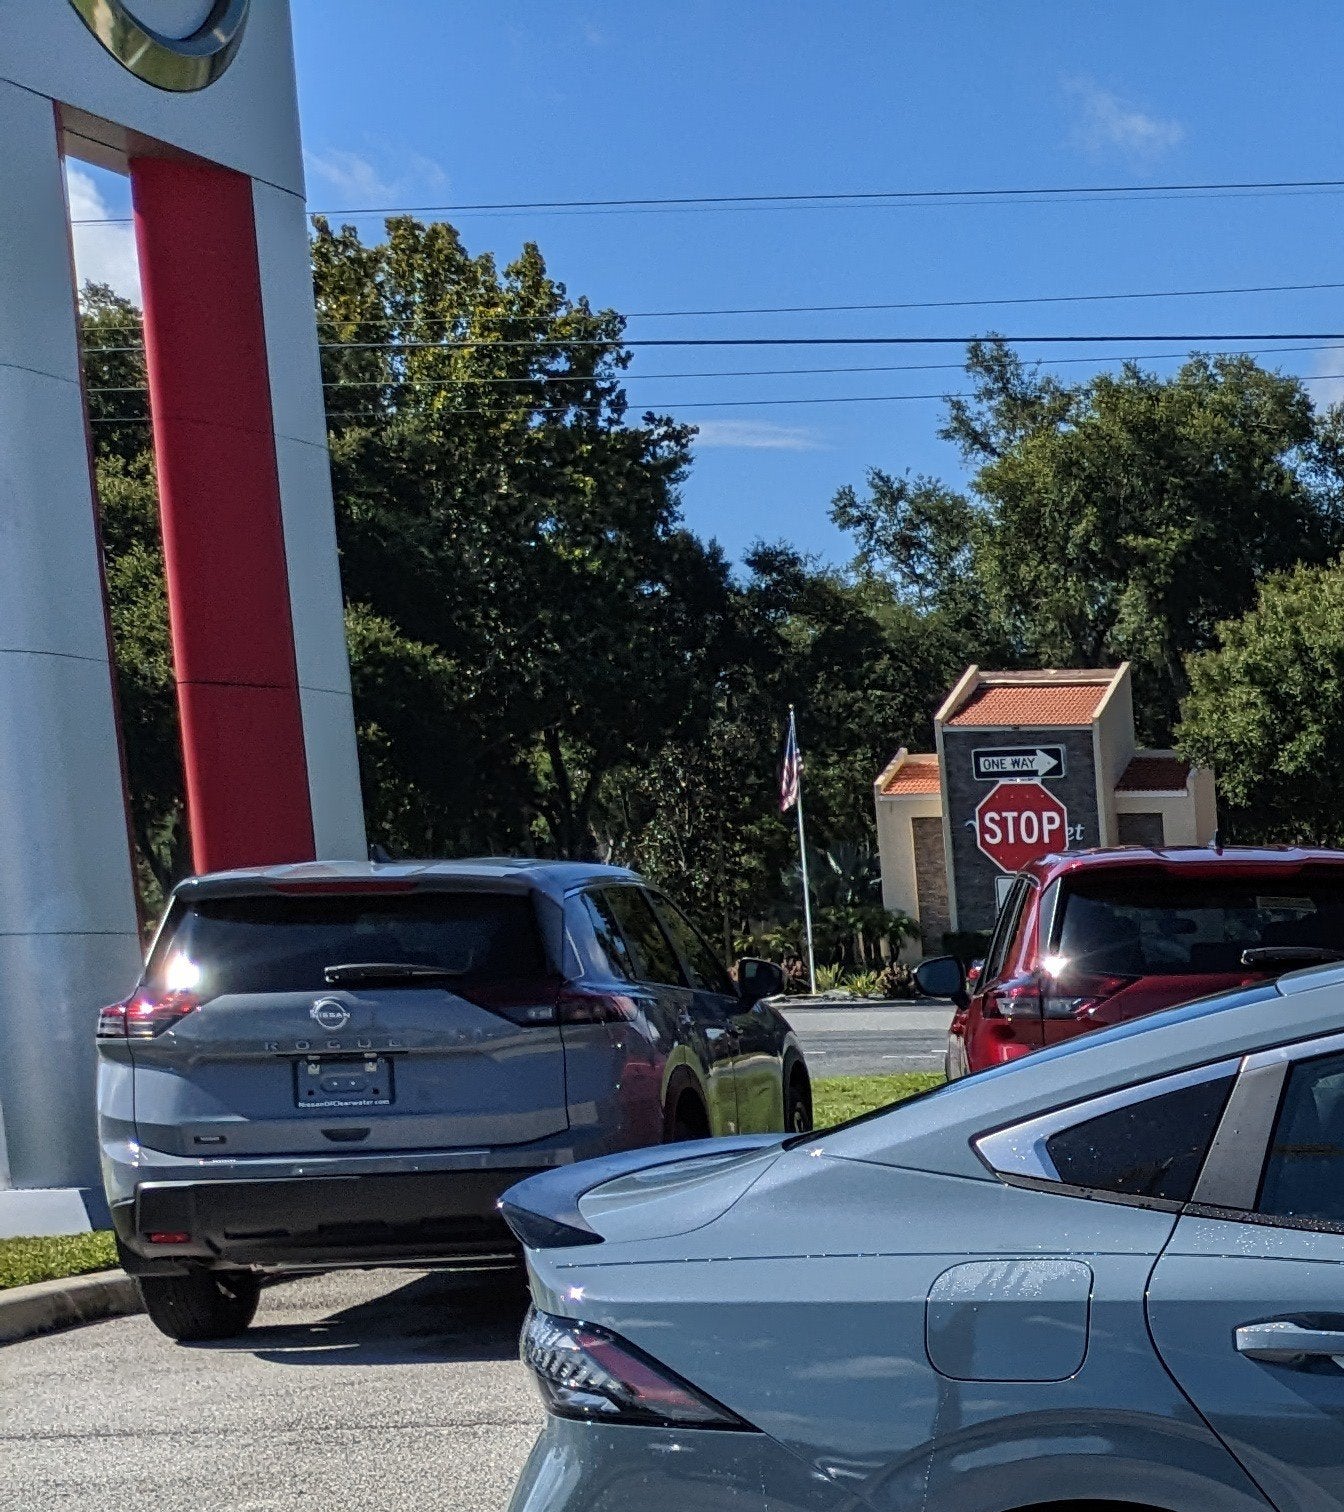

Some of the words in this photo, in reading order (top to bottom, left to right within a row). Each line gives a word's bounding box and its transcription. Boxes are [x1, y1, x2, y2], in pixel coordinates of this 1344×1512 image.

[983, 758, 1007, 770] ONE
[1010, 757, 1036, 769] WAY
[983, 811, 1061, 844] STOP
[310, 1008, 351, 1019] NISSAN
